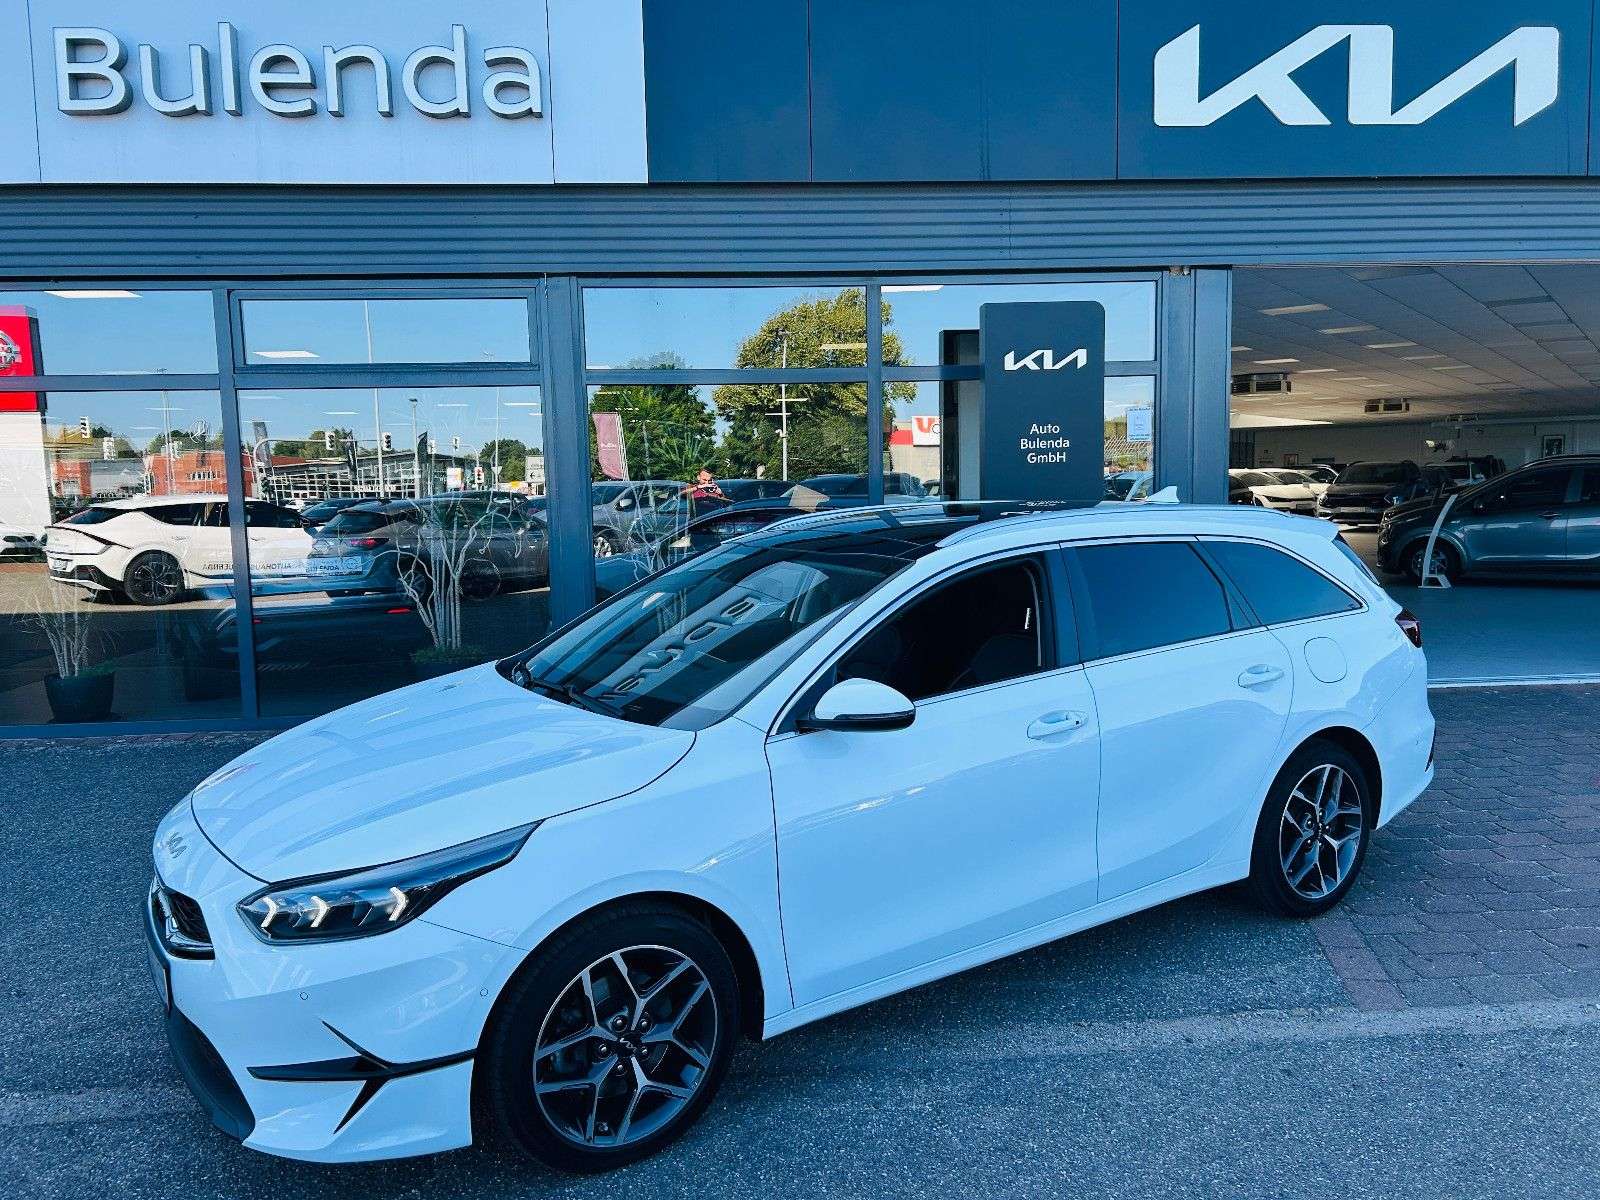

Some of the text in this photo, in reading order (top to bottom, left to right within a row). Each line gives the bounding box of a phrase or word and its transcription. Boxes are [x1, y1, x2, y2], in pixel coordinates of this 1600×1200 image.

[52, 22, 543, 119] Bulenda
[1153, 23, 1560, 128] KIA
[1004, 348, 1087, 370] KIA
[1029, 423, 1060, 435] Auto
[1020, 437, 1070, 450] Bulenda
[1026, 452, 1066, 463] GmbH
